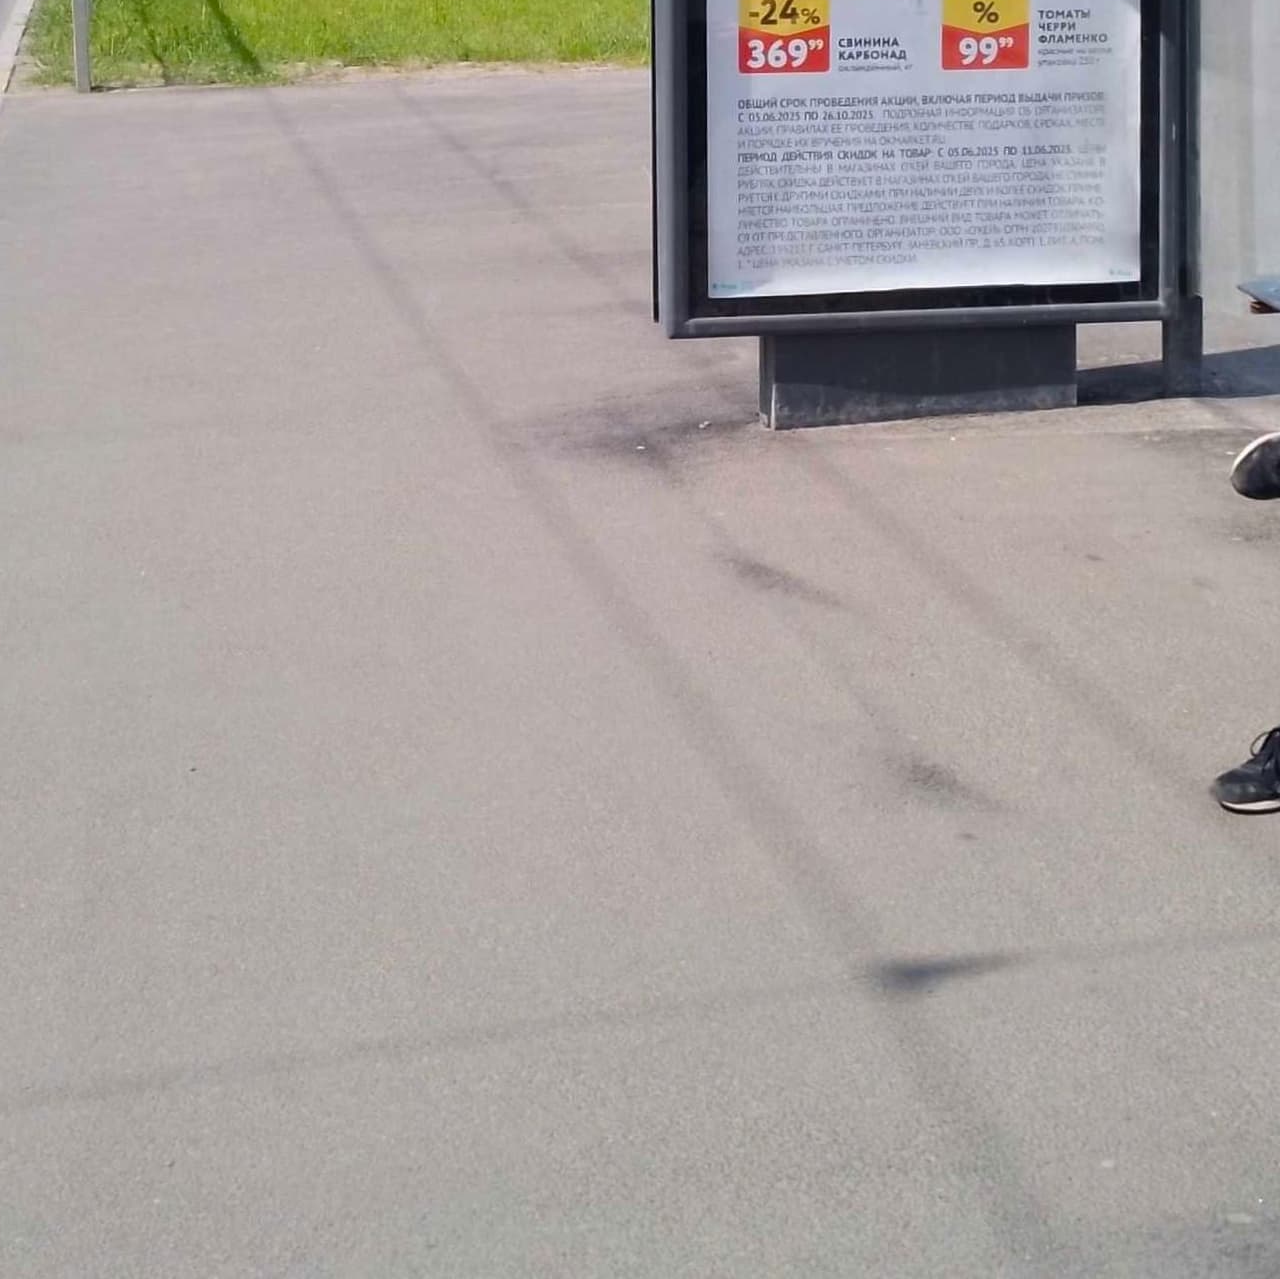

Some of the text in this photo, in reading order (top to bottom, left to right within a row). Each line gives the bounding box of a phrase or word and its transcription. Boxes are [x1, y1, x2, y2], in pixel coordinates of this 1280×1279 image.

[972, 1, 1000, 24] %
[1037, 8, 1091, 20] ТОМАТЫ
[1038, 22, 1076, 32] ЧЕРРИ
[838, 36, 900, 48] СВИНИНА
[1037, 33, 1108, 44] ФЛАМЕНКО
[838, 50, 907, 61] КАРБОНАД
[804, 112, 818, 121] ПО
